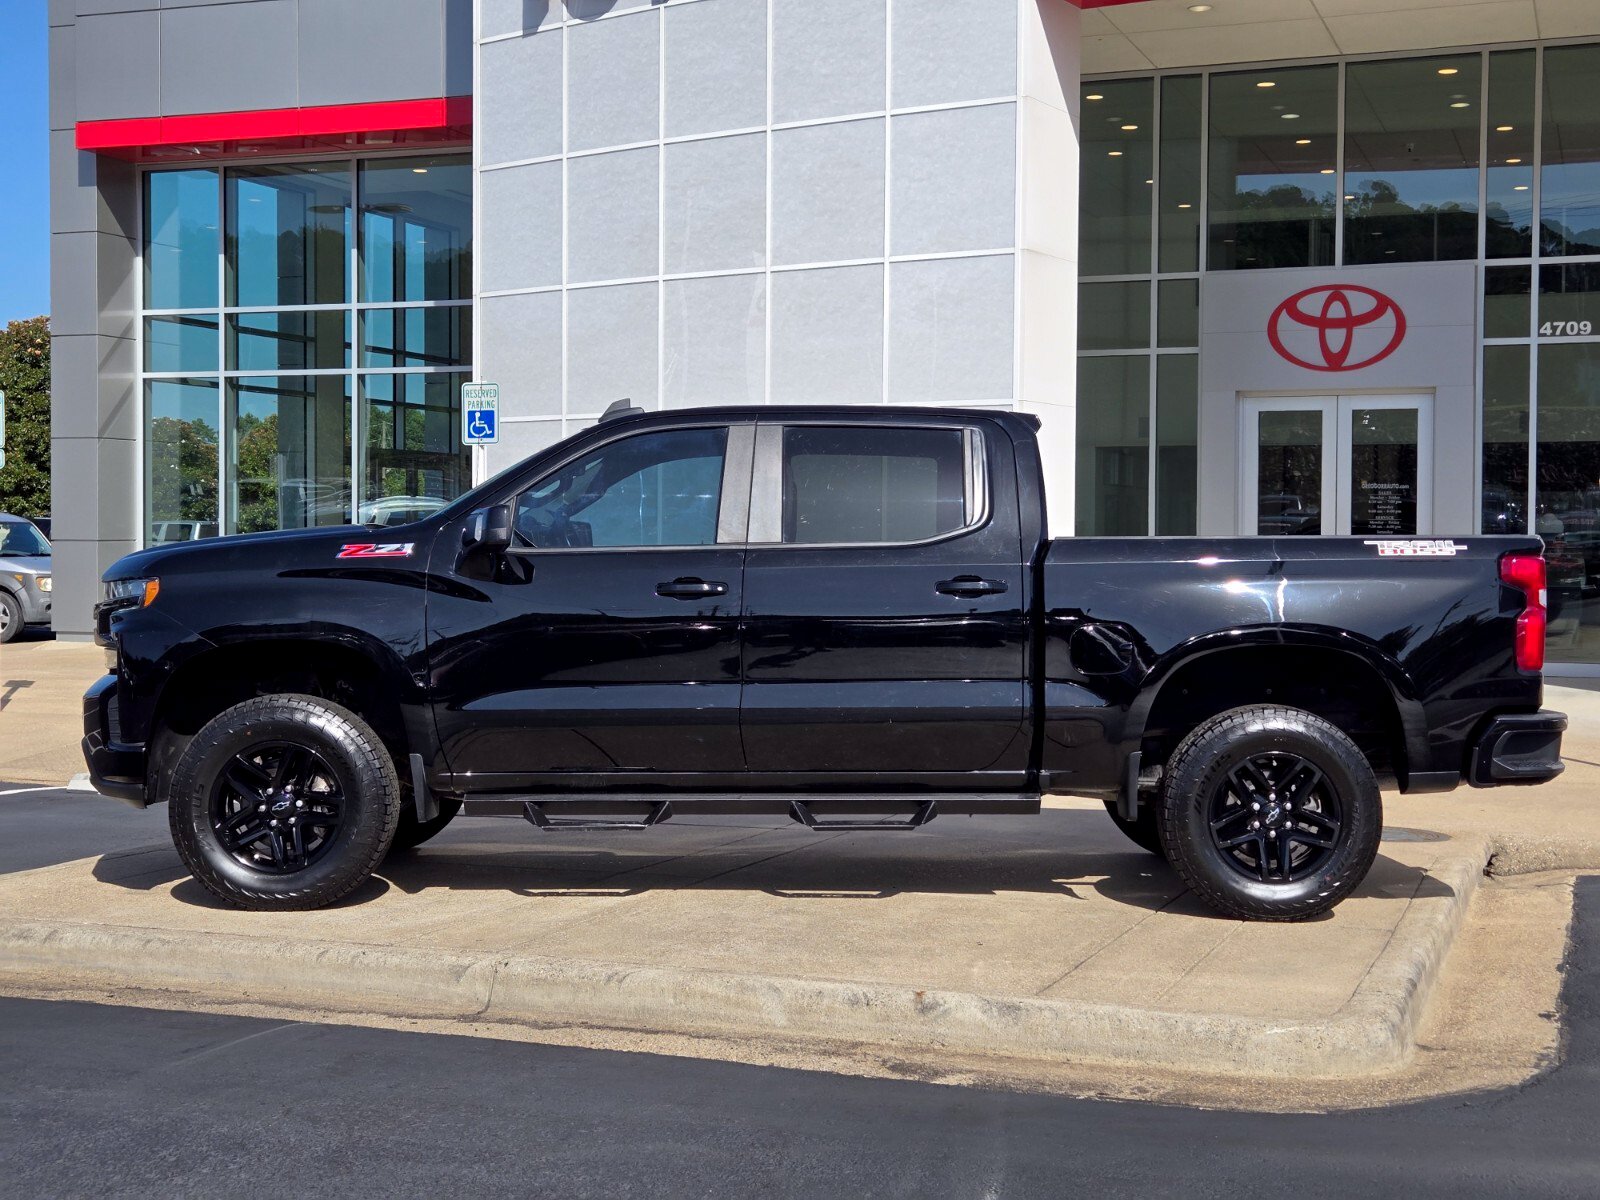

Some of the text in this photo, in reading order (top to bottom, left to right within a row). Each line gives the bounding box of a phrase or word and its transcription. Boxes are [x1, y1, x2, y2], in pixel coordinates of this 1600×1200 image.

[1539, 321, 1592, 336] 4709
[465, 388, 497, 399] RESERVED
[467, 400, 496, 409] PARKING
[335, 542, 415, 559] Z71
